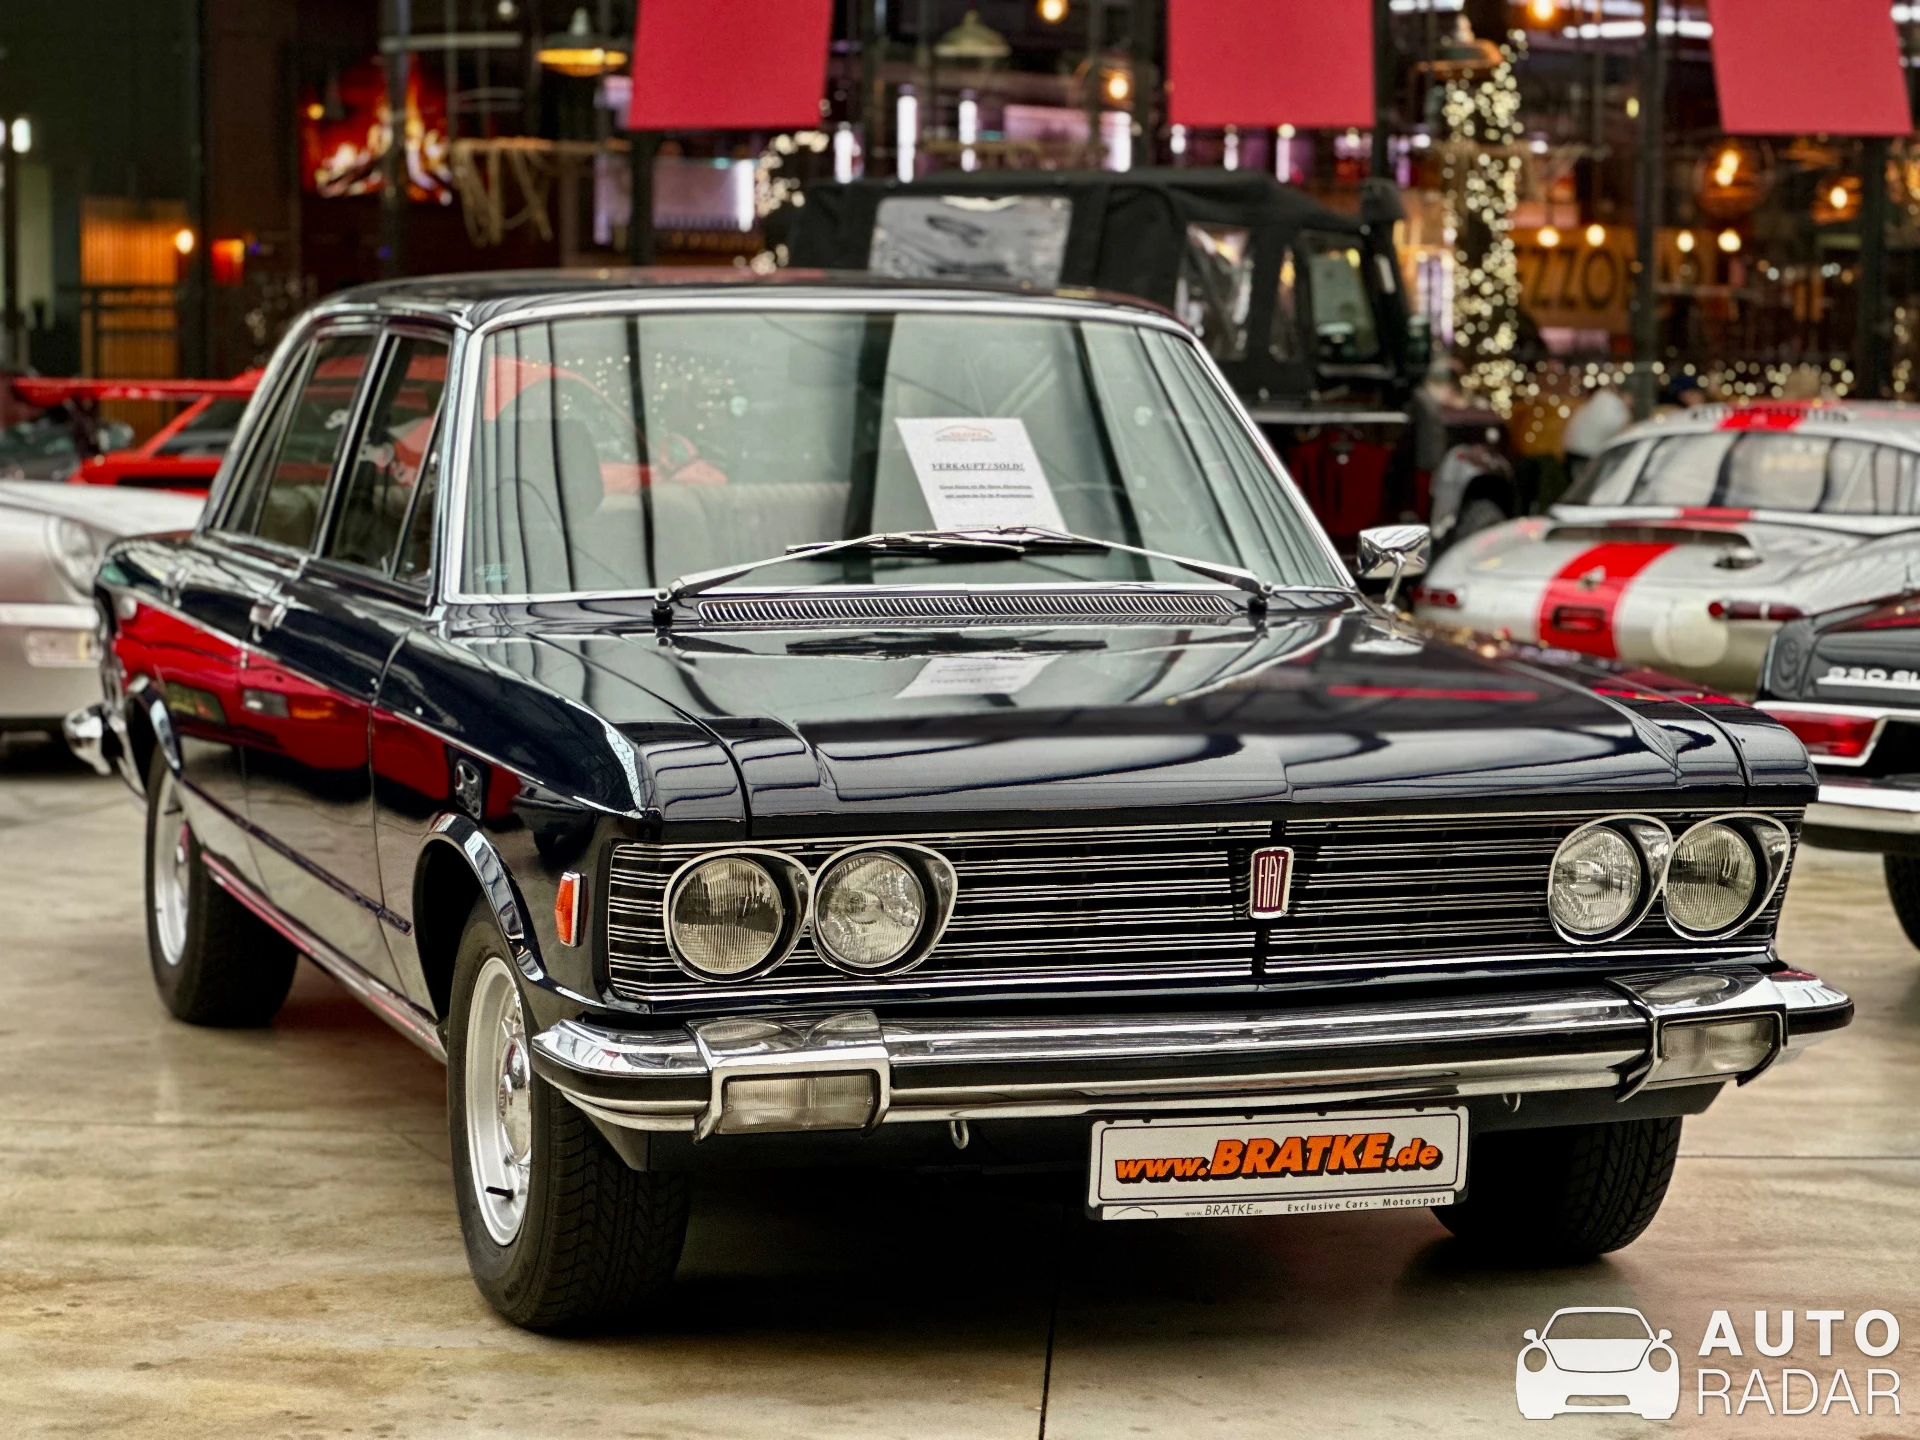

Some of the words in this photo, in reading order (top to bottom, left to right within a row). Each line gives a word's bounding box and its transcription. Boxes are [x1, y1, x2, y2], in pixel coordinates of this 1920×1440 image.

[932, 462, 986, 471] VERKAUFT
[1257, 855, 1285, 908] FIAT
[1115, 1133, 1443, 1184] www.BRATKE.de
[1287, 1202, 1340, 1213] Exclusive
[1346, 1200, 1369, 1209] Cars
[1382, 1196, 1447, 1208] Motorsport
